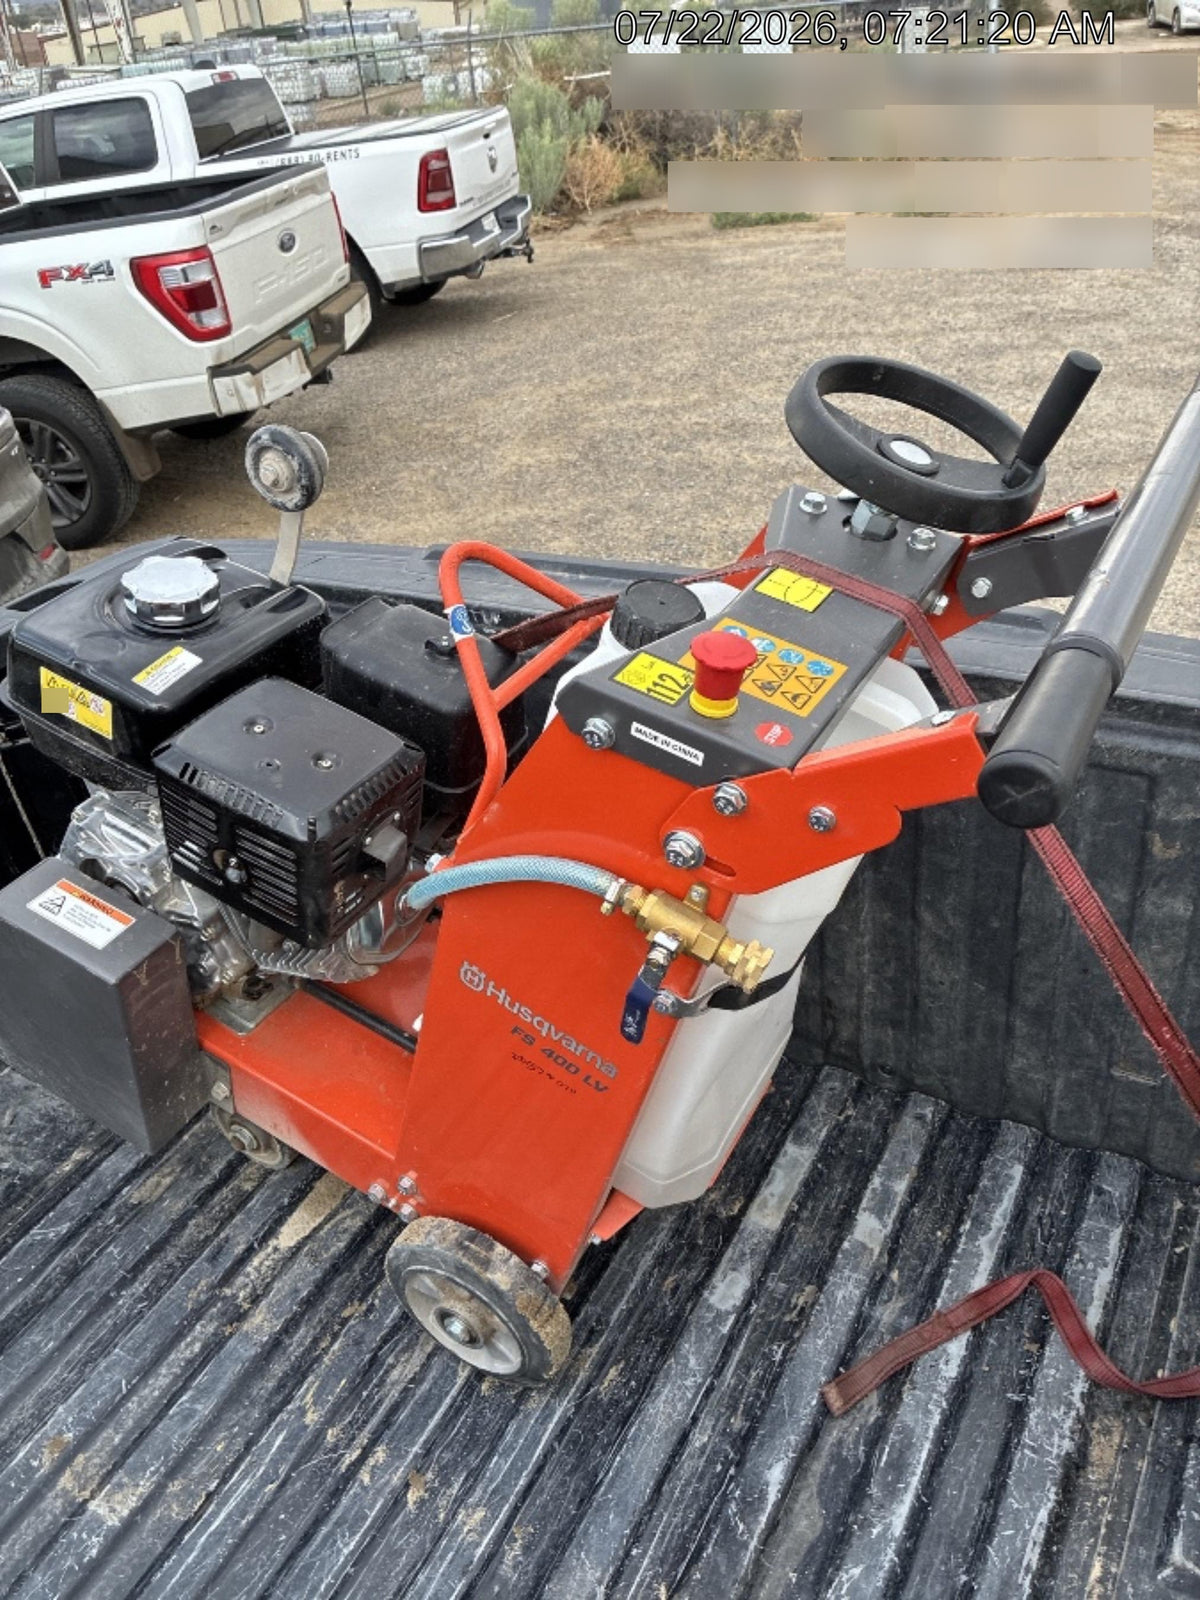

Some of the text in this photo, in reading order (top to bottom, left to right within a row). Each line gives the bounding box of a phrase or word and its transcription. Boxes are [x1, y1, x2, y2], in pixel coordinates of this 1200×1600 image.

[37, 259, 114, 288] FX4
[646, 670, 690, 700] 112
[633, 725, 659, 743] MADE
[670, 743, 700, 761] CHINA
[486, 980, 618, 1078] Husqvarna
[511, 1025, 536, 1046] FS
[540, 1047, 580, 1075] 400
[582, 1074, 609, 1093] LV
